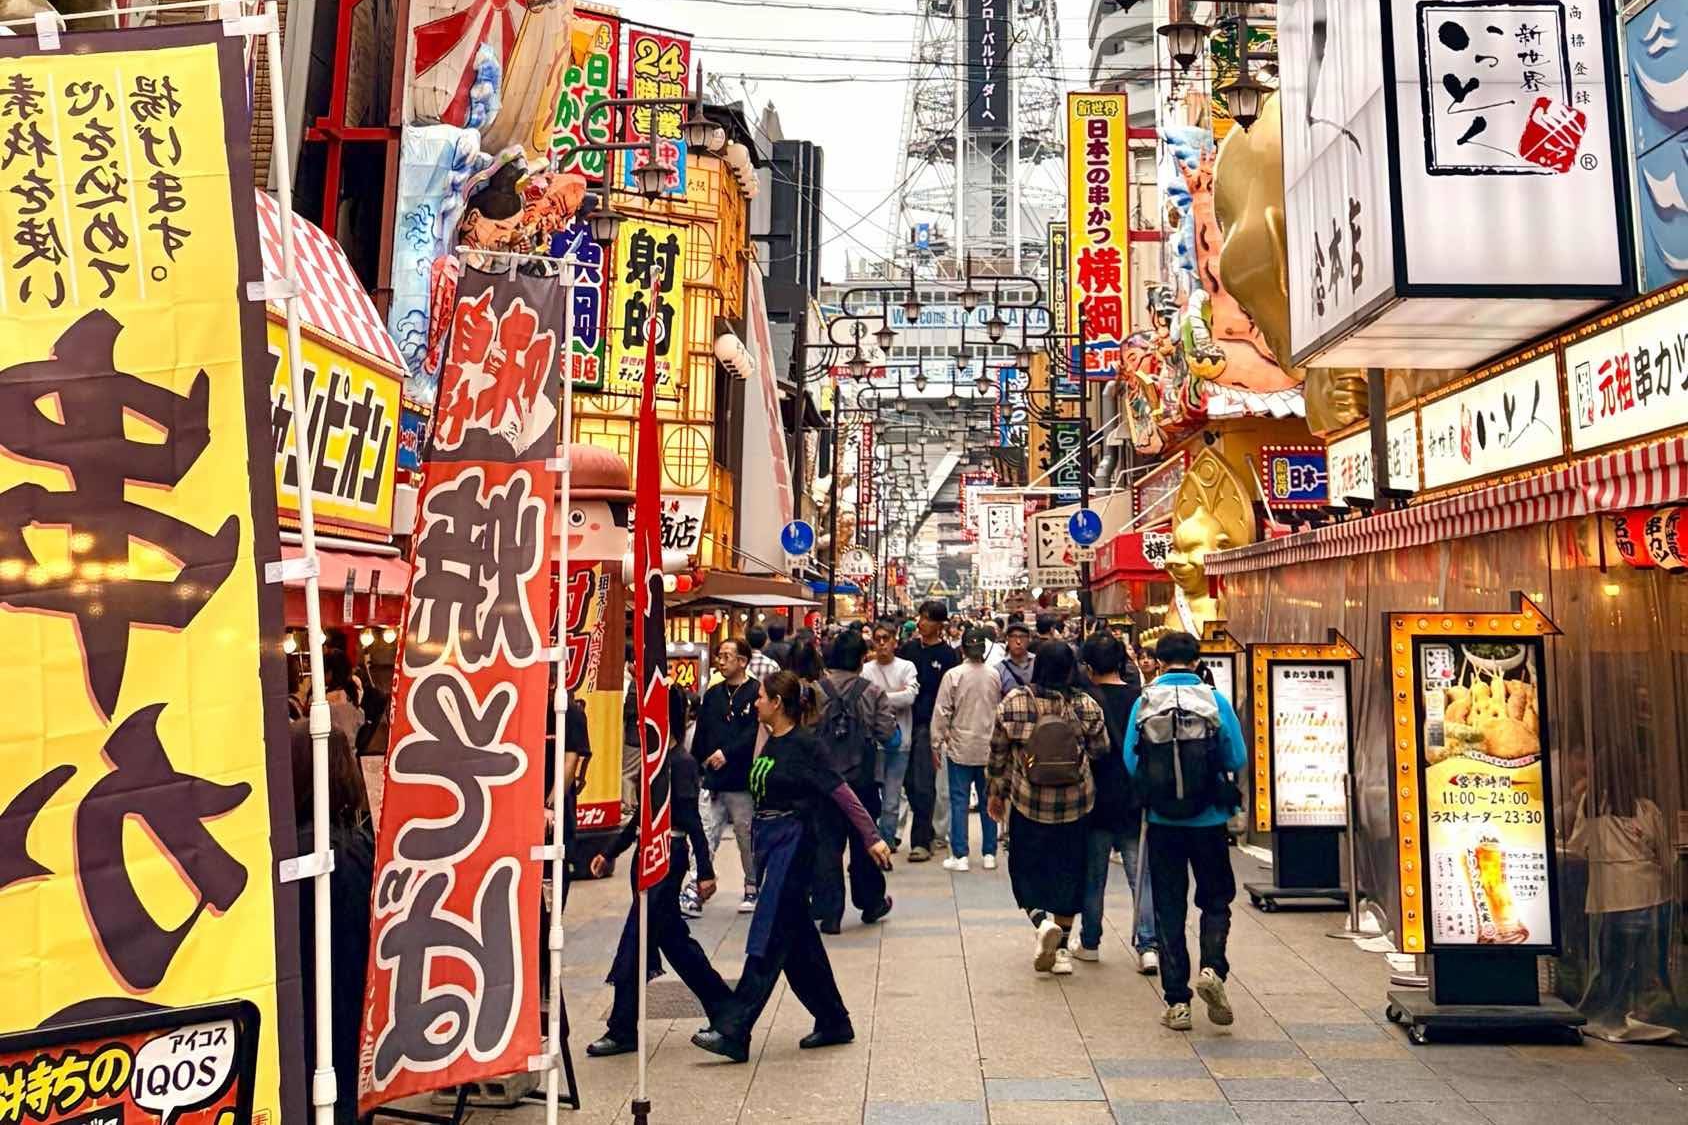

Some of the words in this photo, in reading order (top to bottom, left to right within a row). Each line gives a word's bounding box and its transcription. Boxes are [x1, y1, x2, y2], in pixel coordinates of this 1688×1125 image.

[634, 38, 686, 81] 24
[1515, 24, 1550, 92] 新世界
[1077, 100, 1119, 117] 新世界
[1087, 119, 1111, 243] 日本一の串かつ
[623, 228, 680, 356] 射的
[1077, 247, 1122, 342] 横綱
[892, 307, 945, 324] Wcome
[978, 307, 1047, 324] OAKA
[619, 368, 671, 386] チャンオン
[270, 352, 392, 506] ャンピオン
[676, 663, 695, 688] 24
[1458, 776, 1511, 788] 営業時間
[169, 1026, 228, 1054] アイコス
[0, 1048, 131, 1122] 持ちの
[135, 1056, 217, 1100] IQOS
